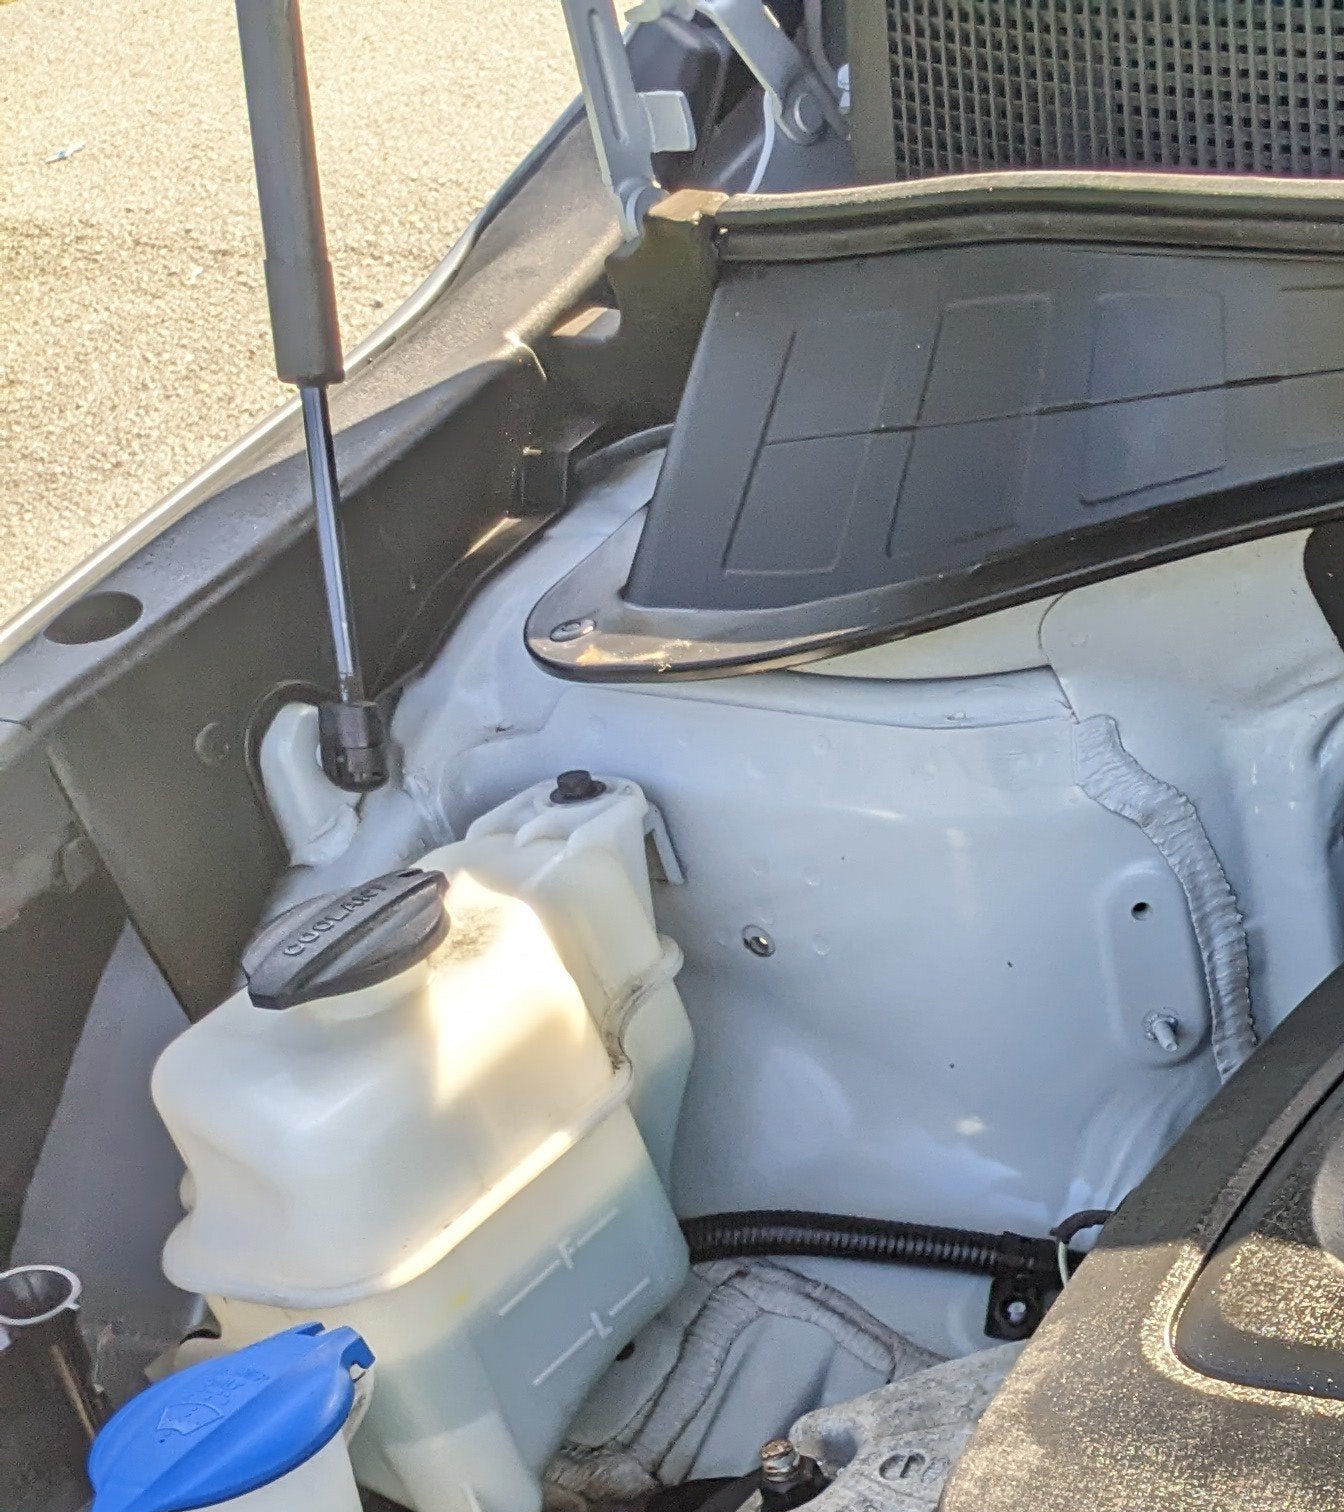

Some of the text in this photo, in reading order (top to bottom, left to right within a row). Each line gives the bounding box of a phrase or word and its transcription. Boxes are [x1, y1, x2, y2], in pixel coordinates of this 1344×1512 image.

[282, 884, 388, 957] COOLANT
[557, 1235, 577, 1270] F
[589, 1310, 615, 1340] L
